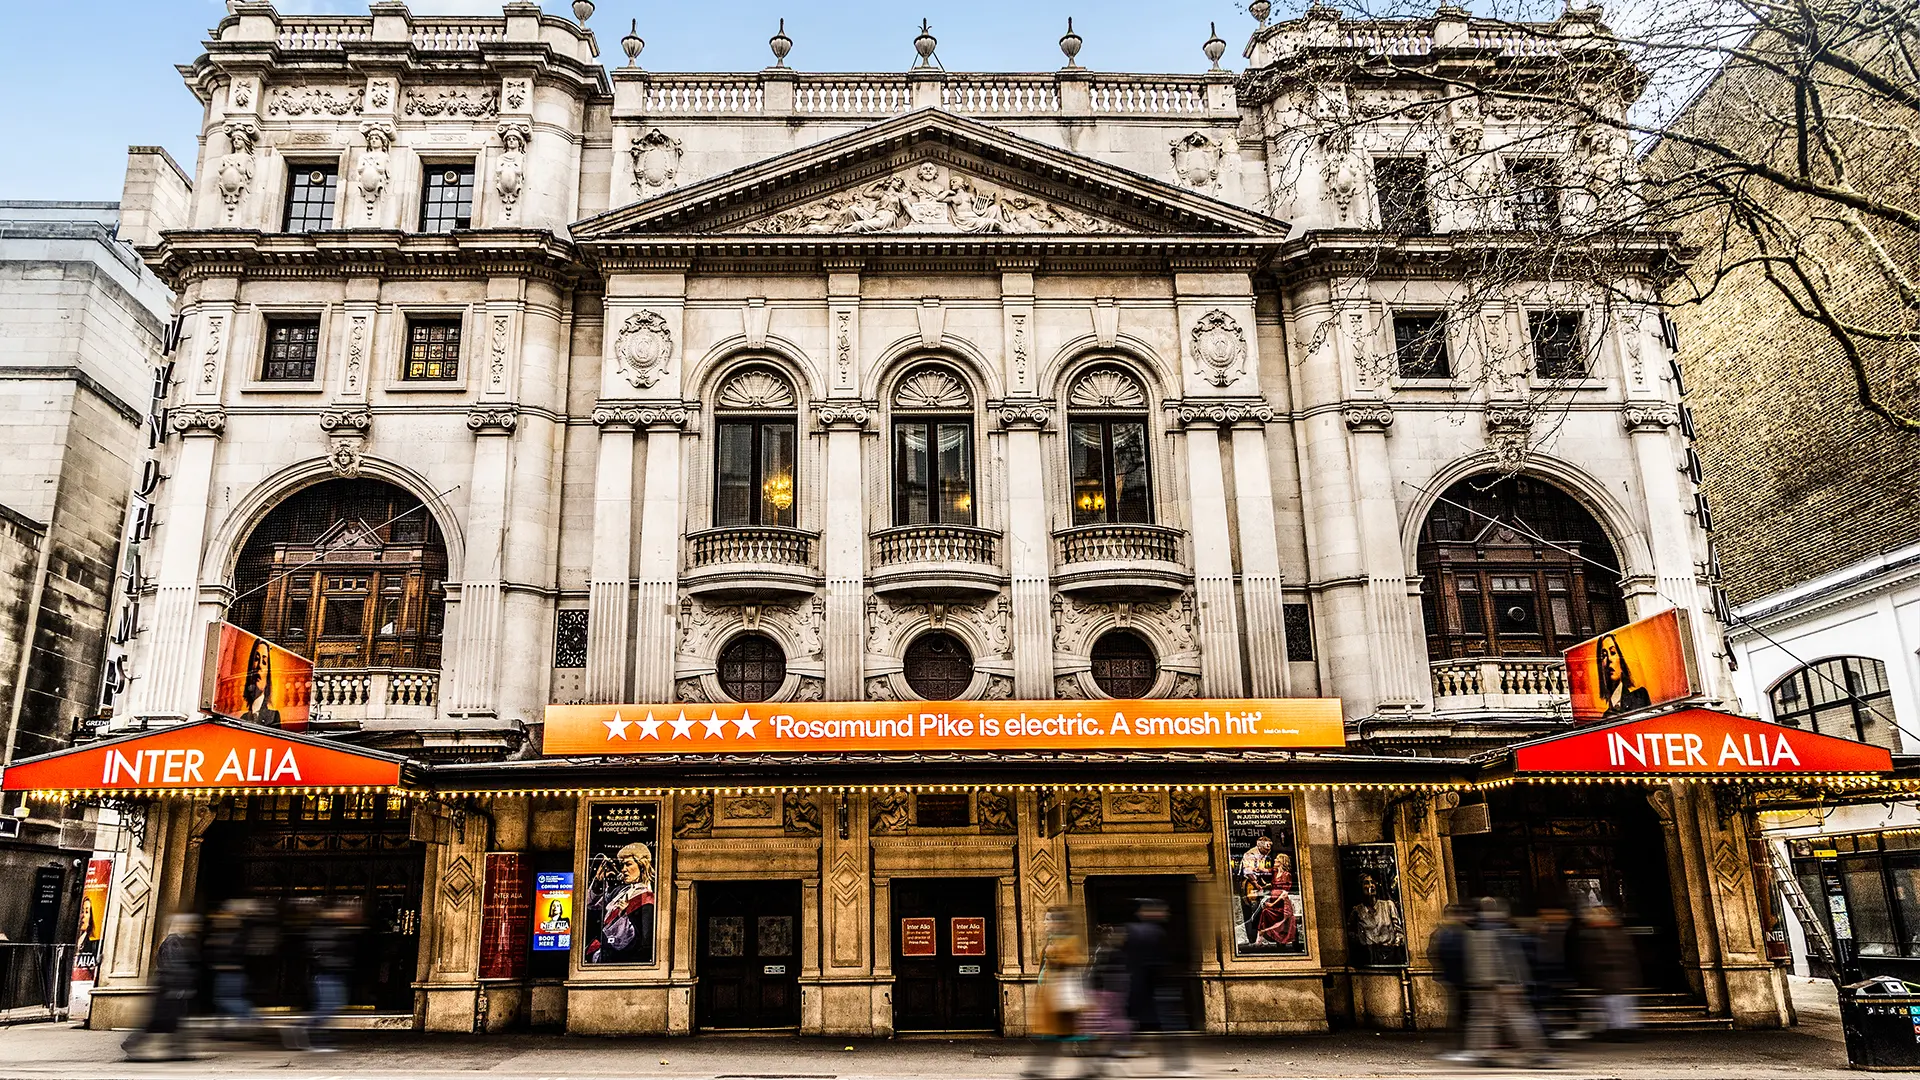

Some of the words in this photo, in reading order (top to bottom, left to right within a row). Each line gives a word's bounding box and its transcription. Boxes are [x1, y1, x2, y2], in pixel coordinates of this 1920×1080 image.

[769, 714, 913, 739] ‘Rosamund
[919, 713, 974, 737] Pike
[979, 713, 1000, 737] is
[1004, 713, 1106, 736] electric.
[1109, 712, 1131, 735] A
[1135, 711, 1221, 735] smash
[1225, 711, 1262, 734] hit’
[102, 748, 205, 785] INTER
[214, 747, 302, 782] ALIA
[1607, 732, 1708, 767] INTER
[1717, 732, 1801, 766] ALIA
